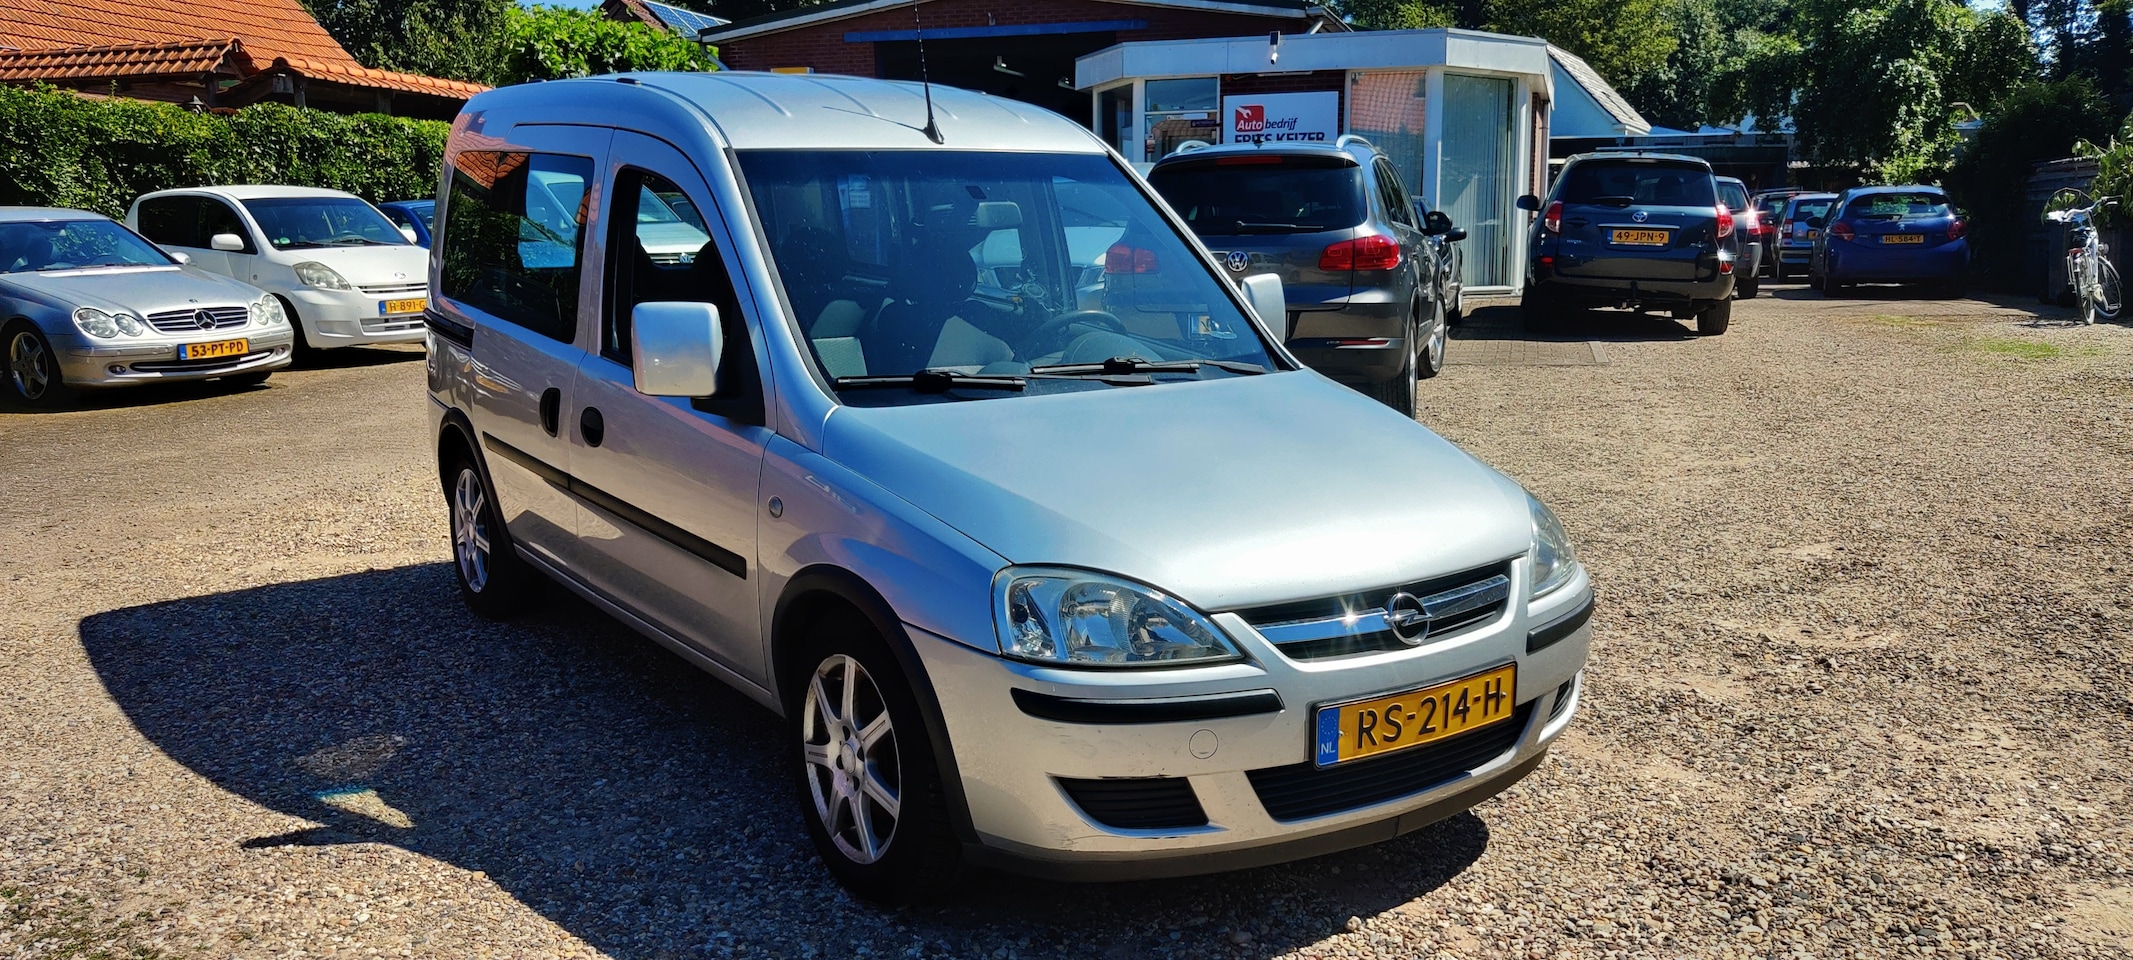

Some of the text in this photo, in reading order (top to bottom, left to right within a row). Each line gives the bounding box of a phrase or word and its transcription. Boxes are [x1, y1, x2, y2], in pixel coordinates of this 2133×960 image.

[1615, 231, 1665, 243] 49-JPN-9
[191, 341, 244, 357] 53-PT-PD
[1321, 676, 1502, 755] NL RS-214-H
